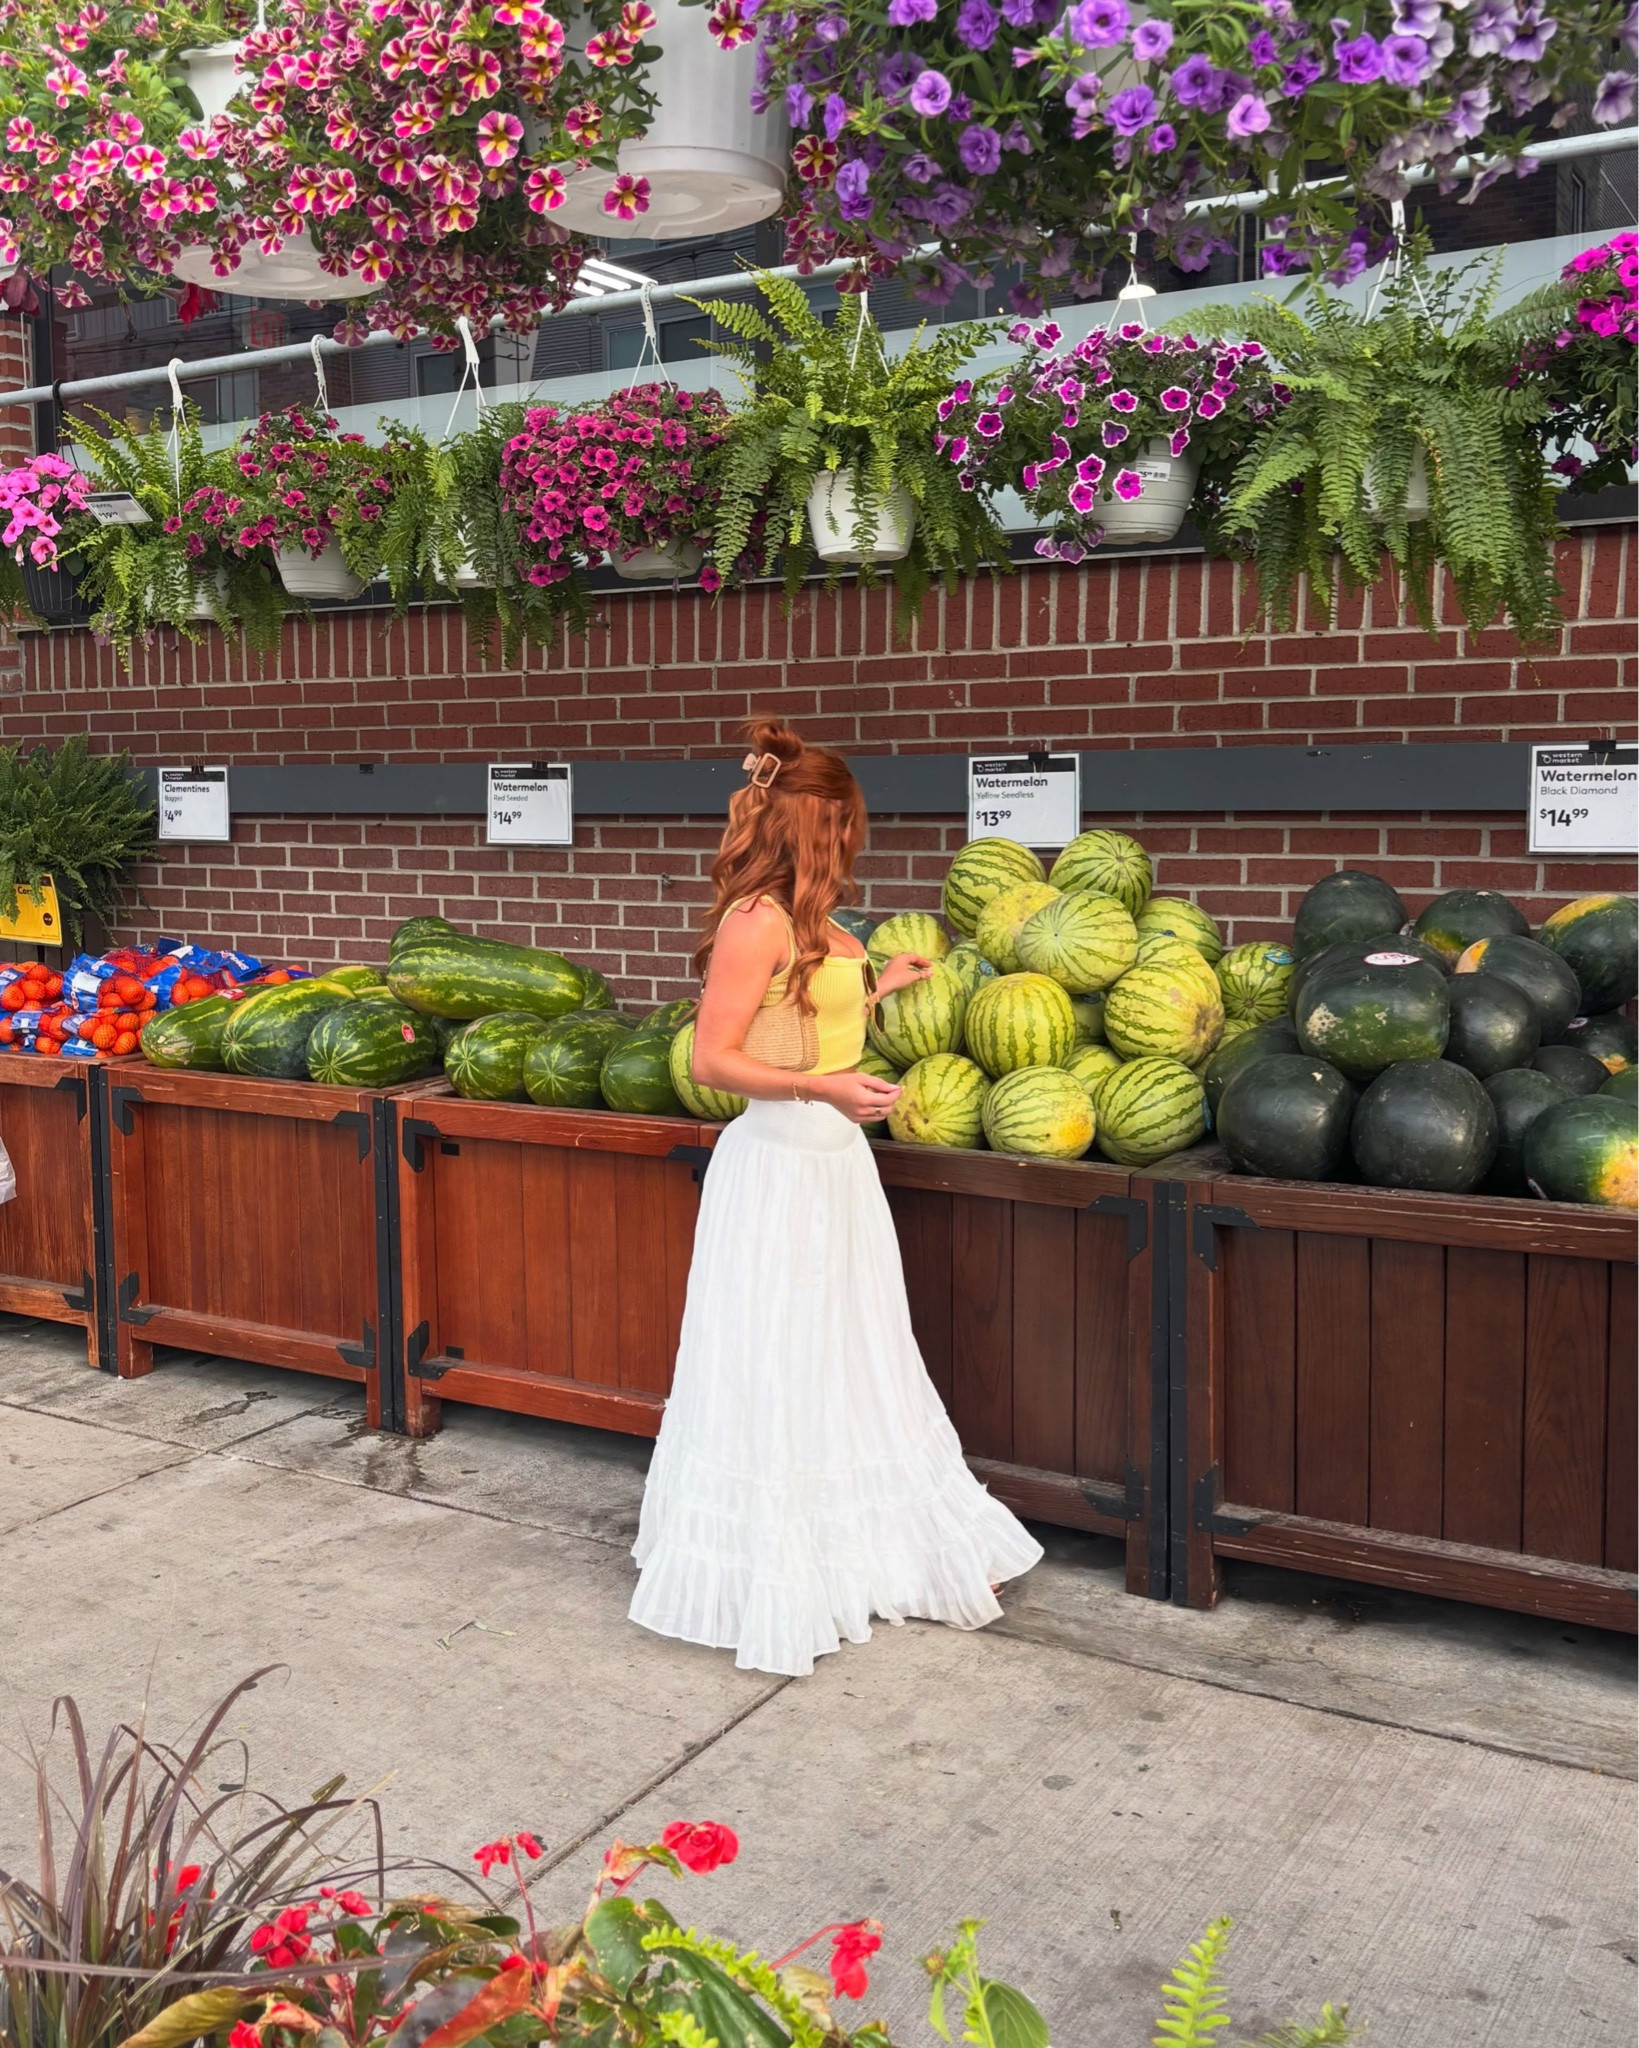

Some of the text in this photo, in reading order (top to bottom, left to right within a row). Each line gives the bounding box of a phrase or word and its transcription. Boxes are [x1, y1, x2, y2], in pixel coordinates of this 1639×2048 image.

[1540, 769, 1638, 782] Watermelon
[493, 782, 548, 791] Watermelon
[975, 776, 1048, 788] Watermelon
[164, 784, 210, 793] Clementines
[1540, 786, 1618, 795] Black Diamond
[1001, 791, 1034, 799] Seedless
